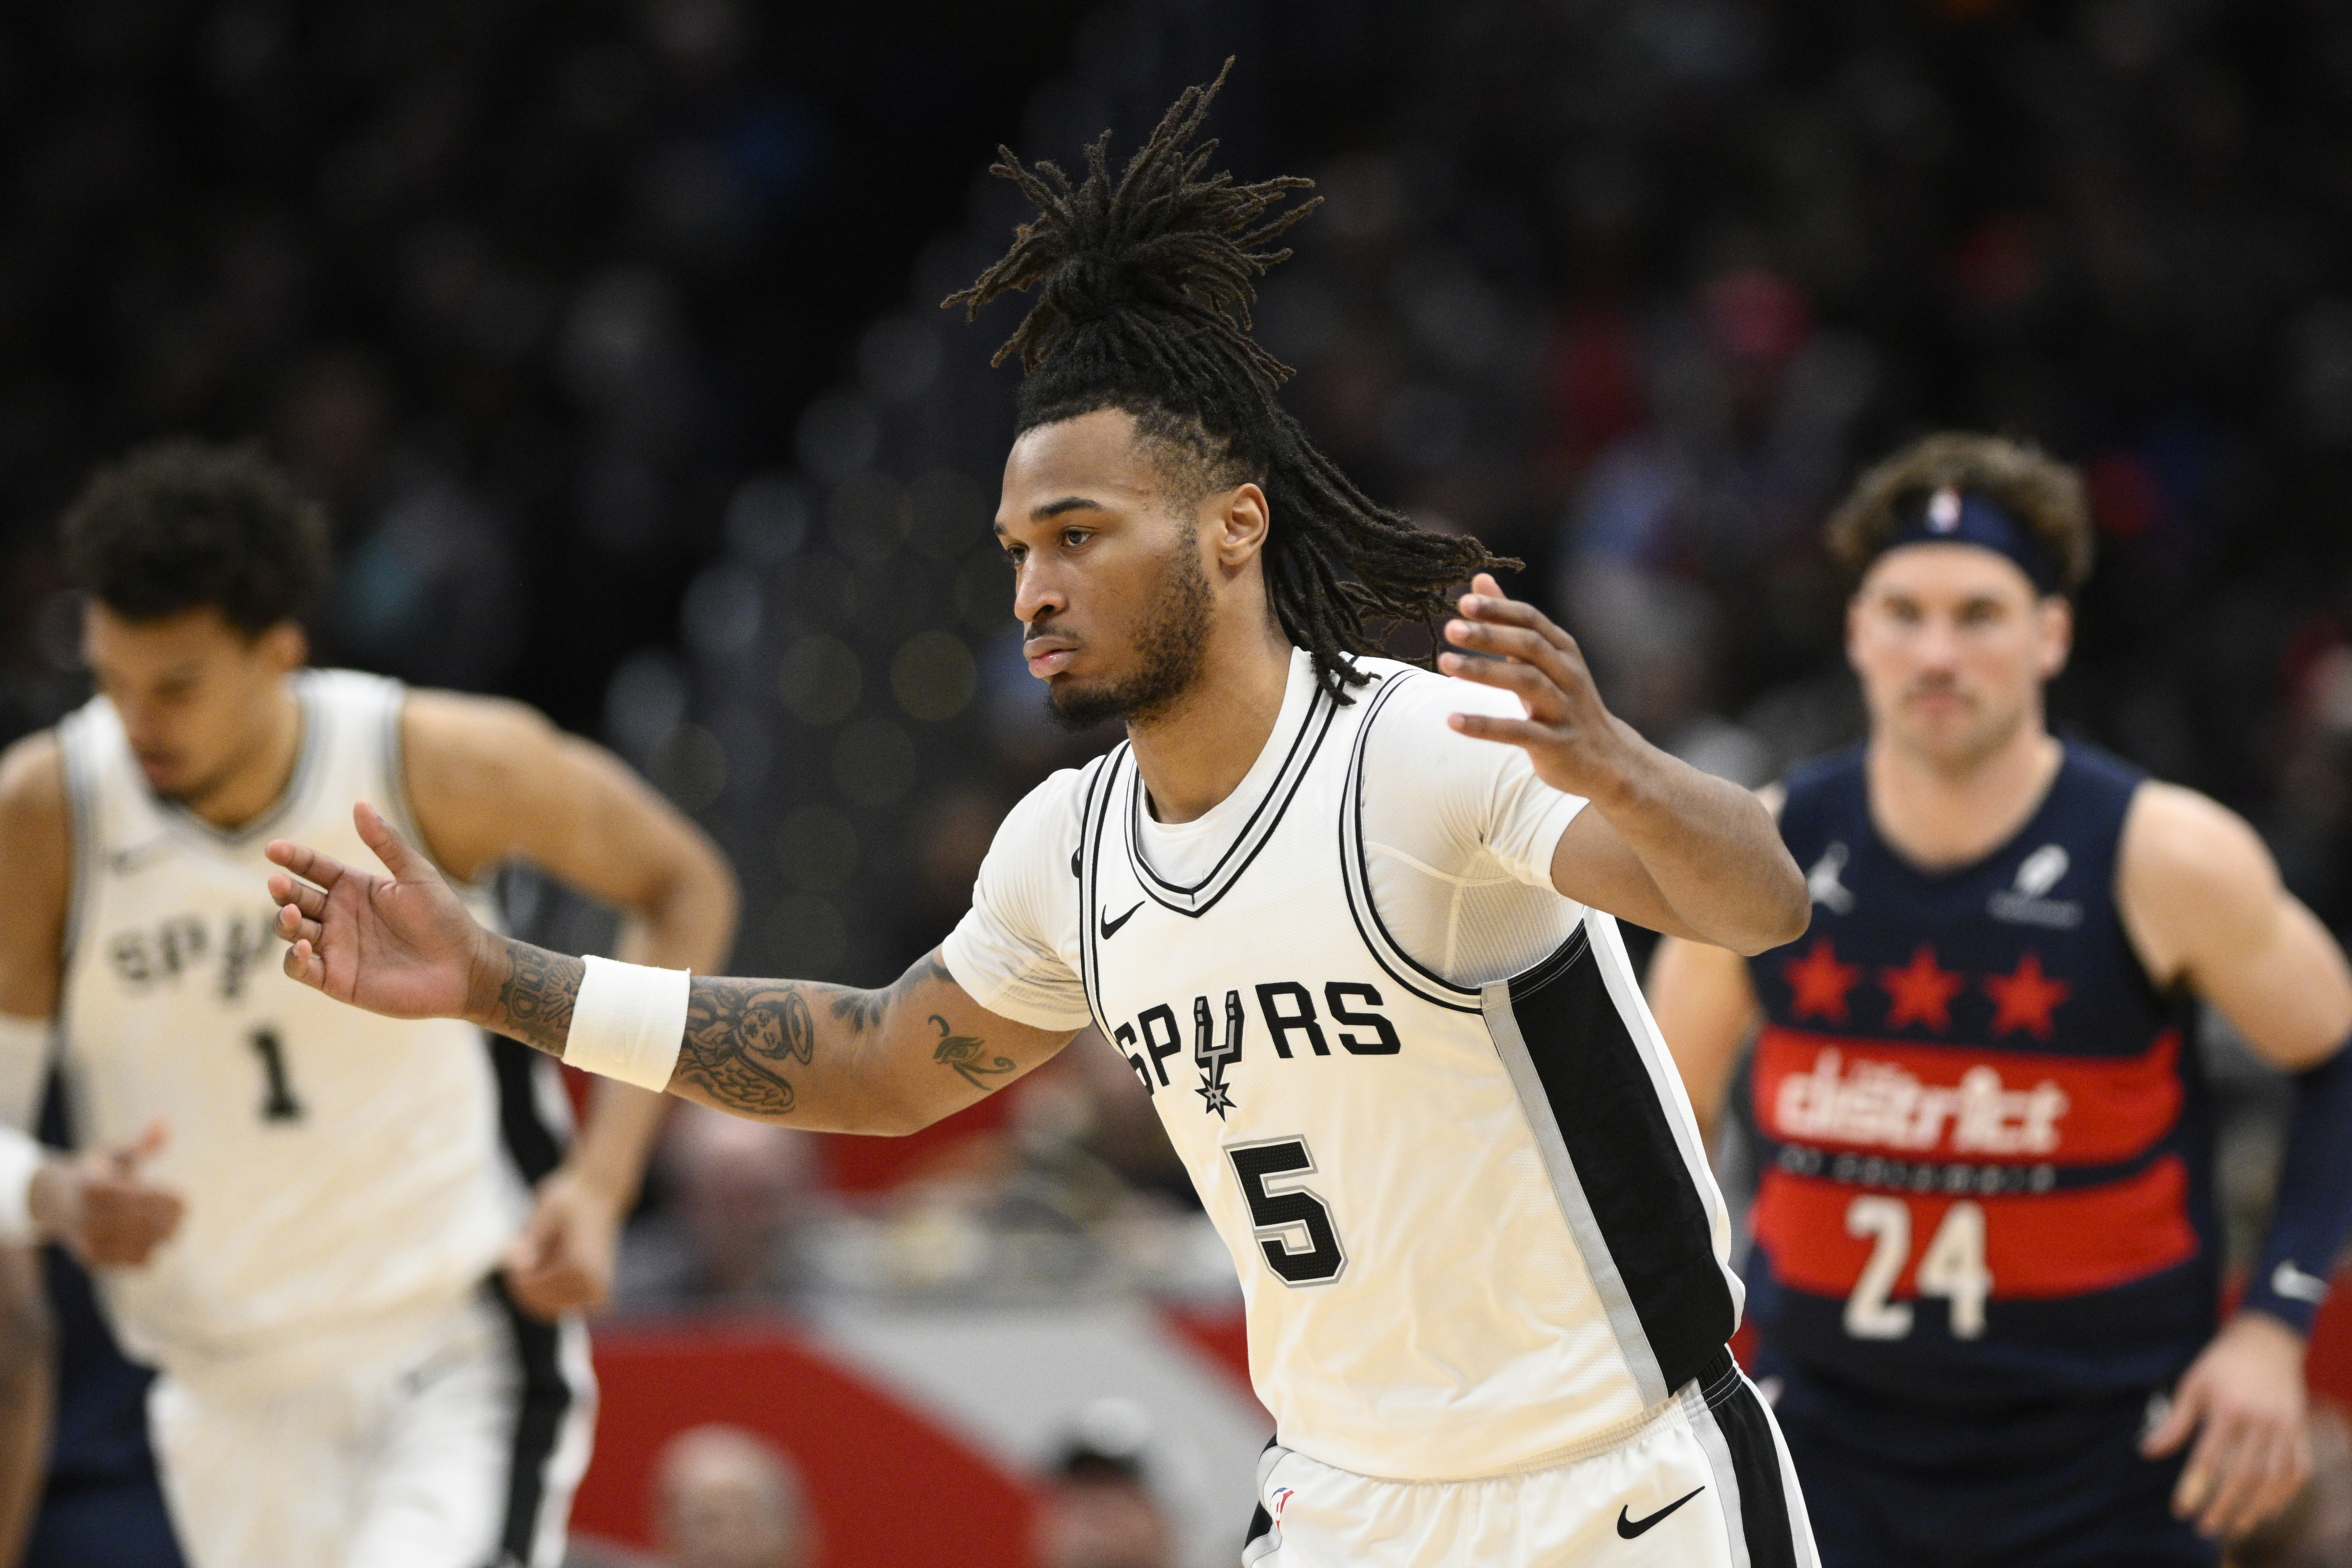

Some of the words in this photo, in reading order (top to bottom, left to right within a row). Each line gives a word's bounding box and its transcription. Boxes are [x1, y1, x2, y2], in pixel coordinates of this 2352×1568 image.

[246, 1026, 307, 1120] 1
[1114, 981, 1401, 1122] SPURS
[1223, 1134, 1348, 1288] 5
[1844, 1194, 1994, 1339] 24
